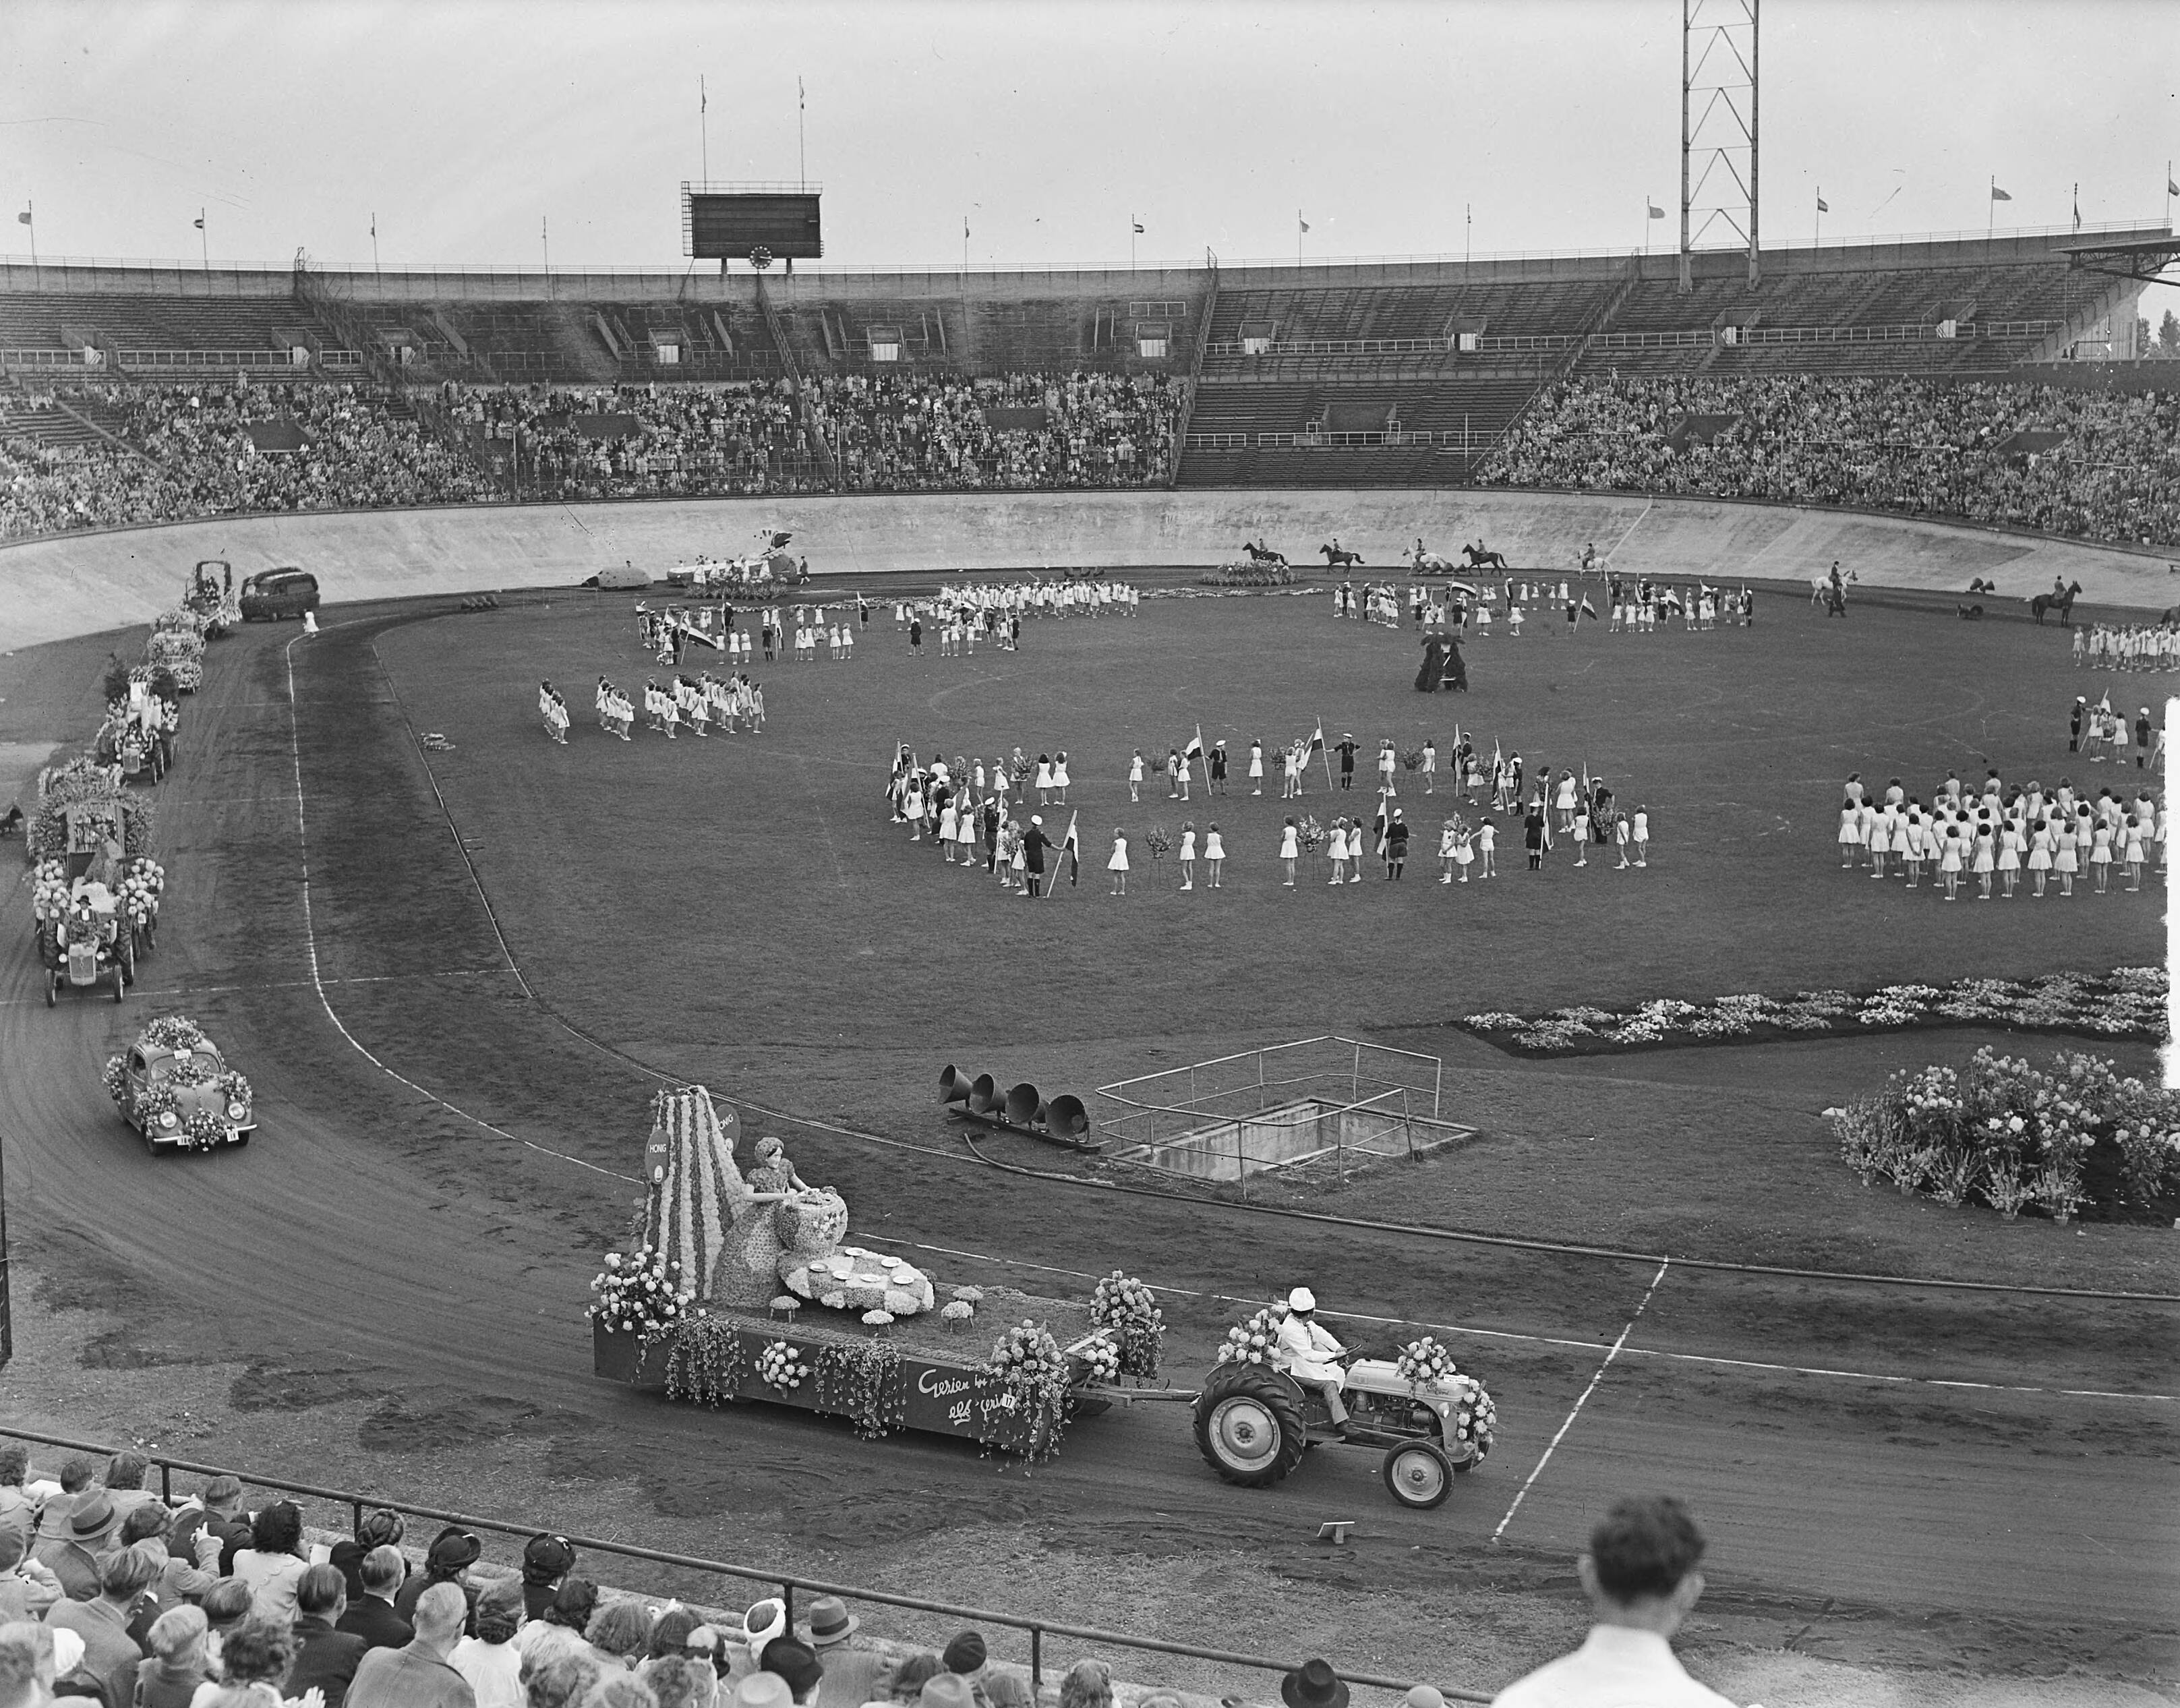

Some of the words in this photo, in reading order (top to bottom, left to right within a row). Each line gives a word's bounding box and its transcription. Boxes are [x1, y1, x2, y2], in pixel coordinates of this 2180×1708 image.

[719, 1114, 734, 1129] ONIG
[649, 1144, 667, 1153] HONIG
[1005, 1396, 1013, 1407] 17
